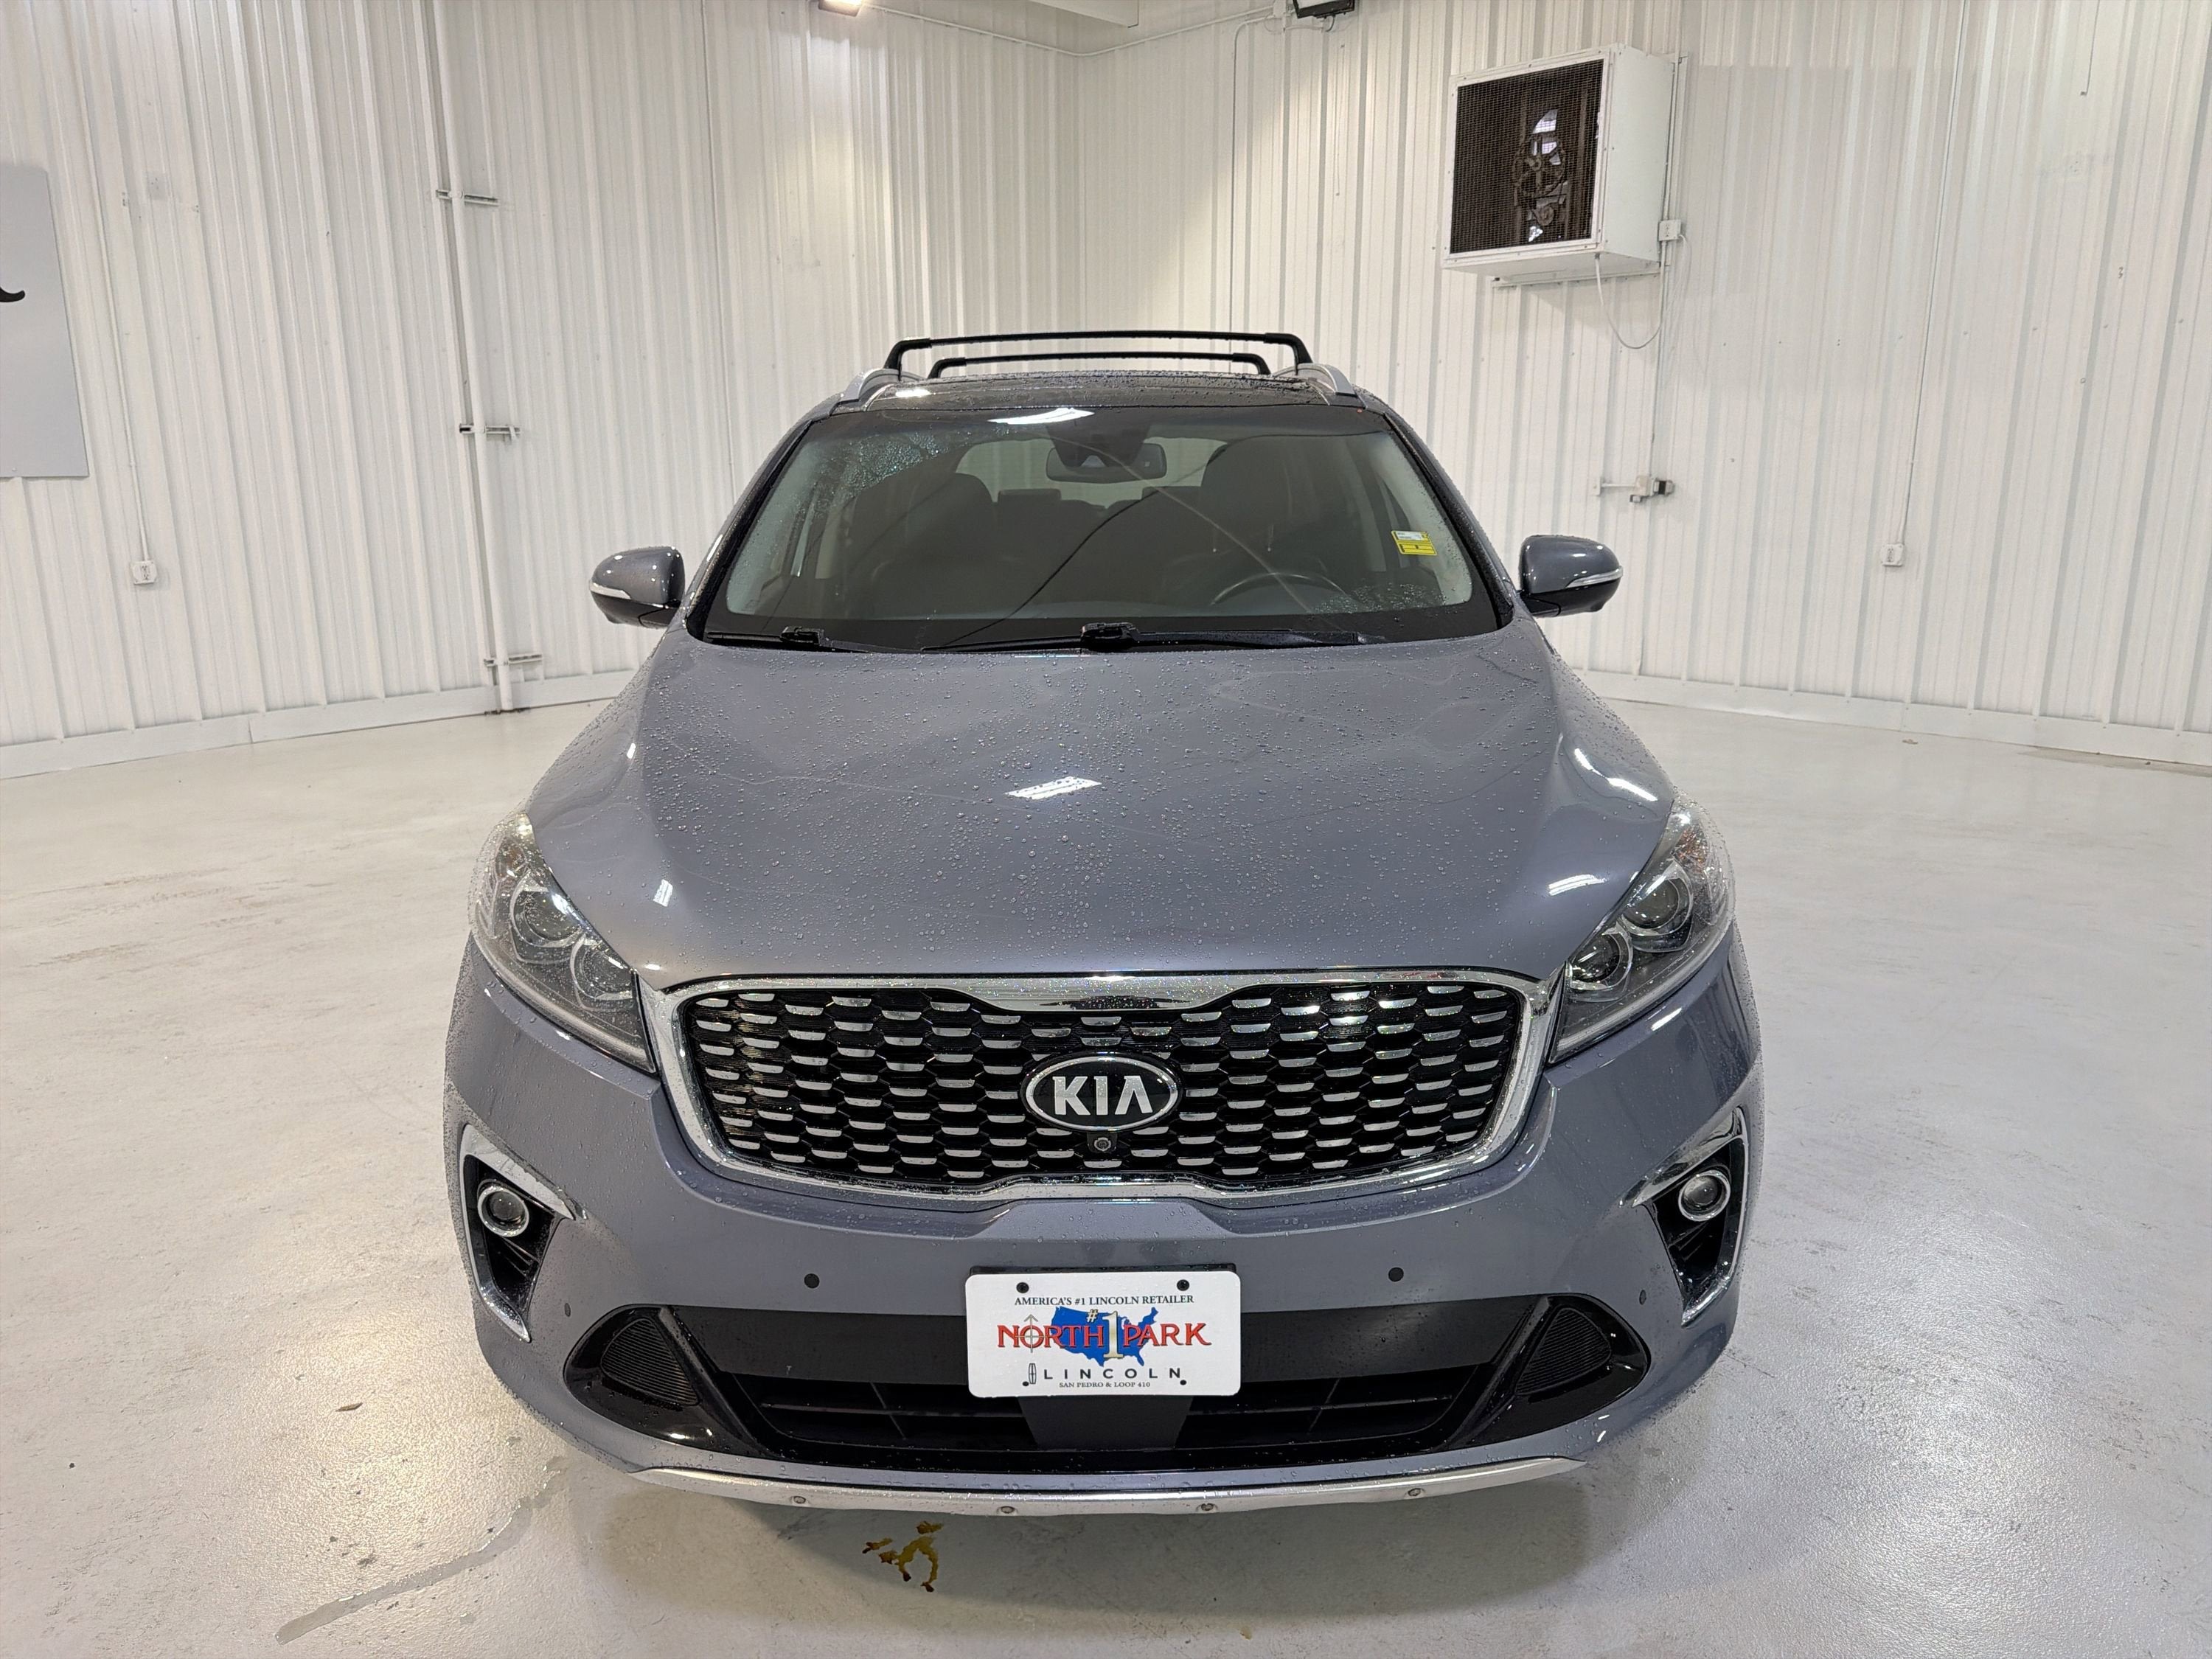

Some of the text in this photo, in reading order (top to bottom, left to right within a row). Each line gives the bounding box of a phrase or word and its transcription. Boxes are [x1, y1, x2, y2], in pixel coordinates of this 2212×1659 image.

[1052, 1076, 1153, 1116] KIA
[1015, 1296, 1072, 1306] AMERICA'S
[1088, 1296, 1139, 1305] LINCOLN
[1141, 1295, 1194, 1304] RETAILER
[997, 1324, 1104, 1348] NORTH
[1123, 1323, 1211, 1346] PARK
[1044, 1368, 1180, 1379] LINCOLN
